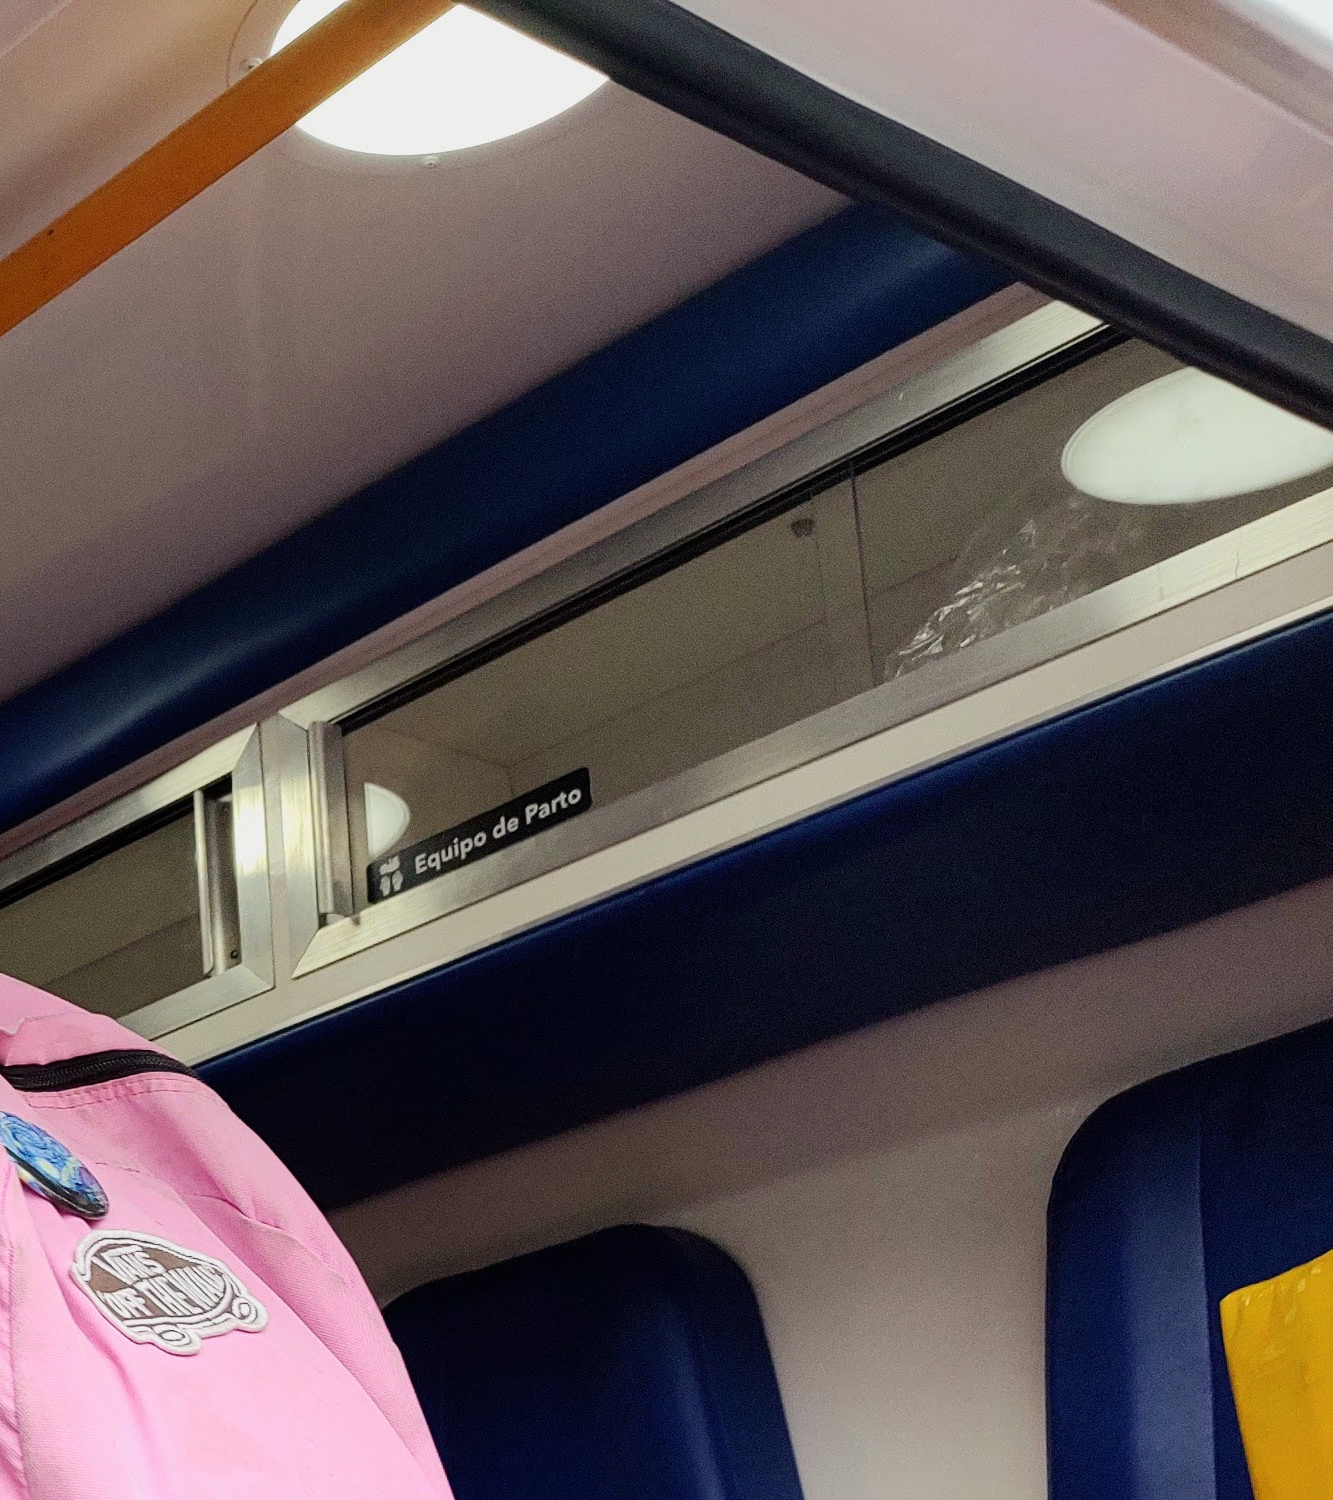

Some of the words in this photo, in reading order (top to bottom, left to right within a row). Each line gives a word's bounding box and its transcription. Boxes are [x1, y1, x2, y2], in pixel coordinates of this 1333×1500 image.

[414, 830, 487, 875] Equipo
[492, 815, 520, 839] de
[524, 787, 582, 825] Parto
[91, 1244, 166, 1285] VANS
